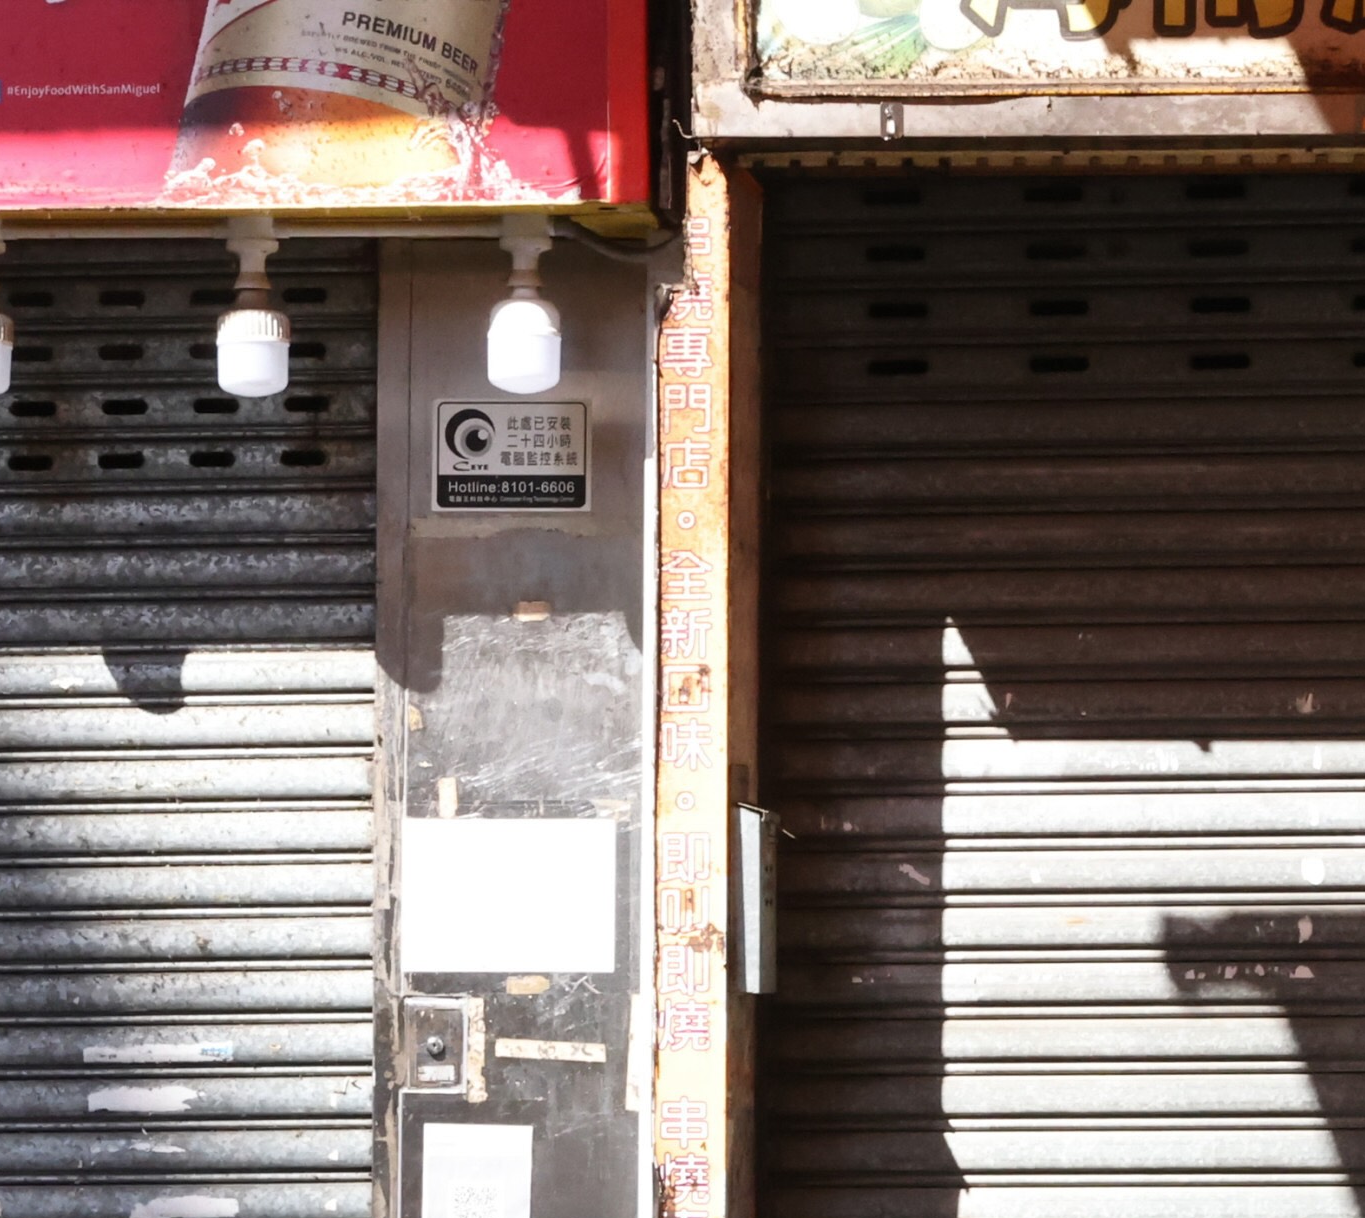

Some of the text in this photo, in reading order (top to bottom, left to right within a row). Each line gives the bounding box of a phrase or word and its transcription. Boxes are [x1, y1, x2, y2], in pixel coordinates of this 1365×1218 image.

[341, 11, 479, 76] PREMIUM BEER
[7, 83, 161, 98] #EnjoyFoodWithSanMiguel
[506, 416, 573, 431] 此處已安裝
[506, 433, 572, 449] 二十四小時
[500, 451, 578, 466] 電腦監控系統
